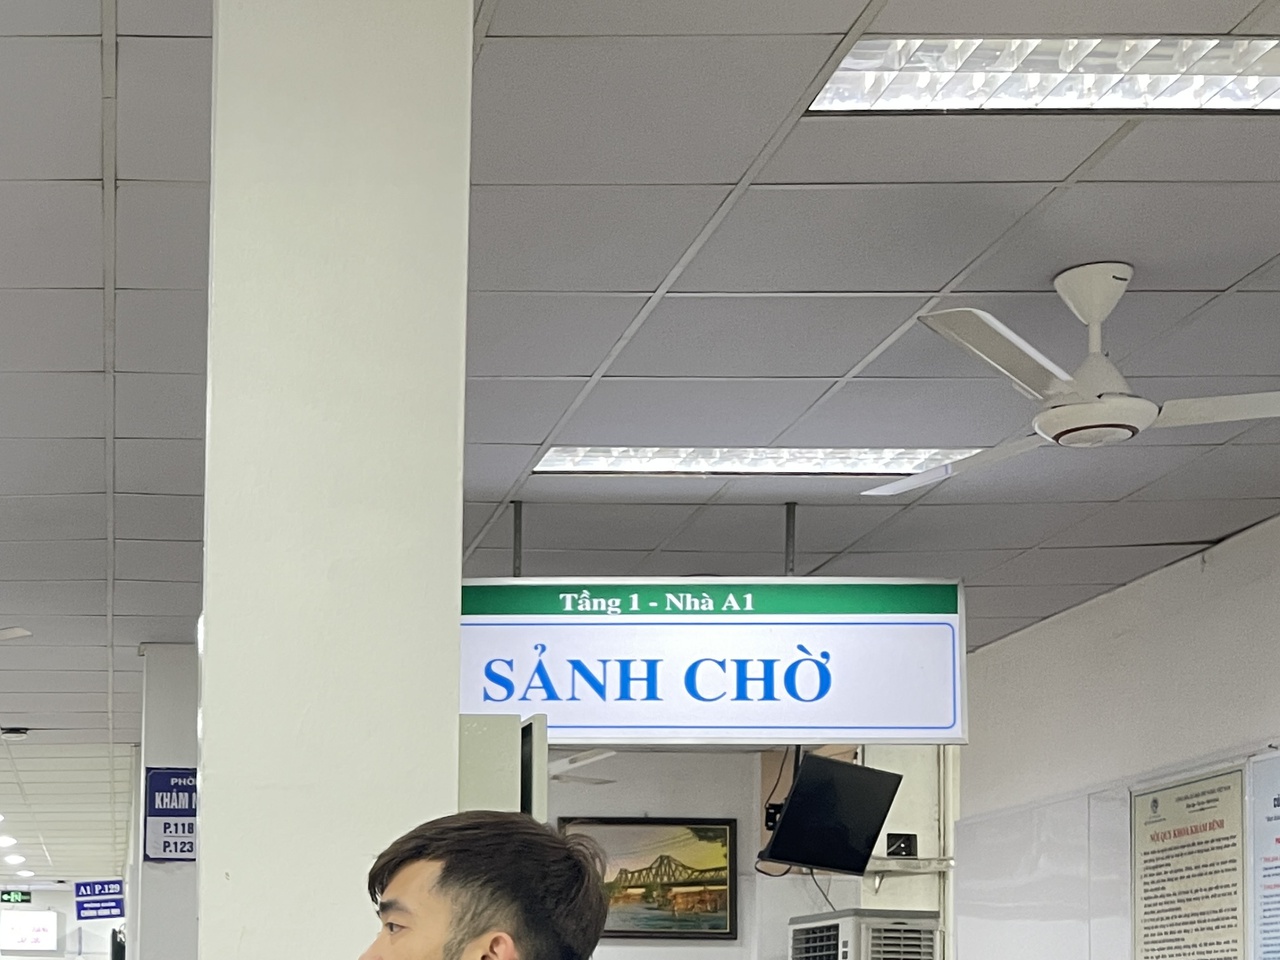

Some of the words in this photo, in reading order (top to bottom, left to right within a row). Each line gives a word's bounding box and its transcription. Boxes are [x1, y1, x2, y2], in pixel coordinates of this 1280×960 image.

[559, 589, 622, 615] Tầng
[629, 594, 641, 611] 1
[665, 592, 715, 612] Nhà
[721, 594, 755, 611] A1
[482, 643, 664, 703] SẢNH
[684, 643, 832, 703] CHỜ
[170, 776, 197, 786] PHÒ
[163, 822, 194, 834] P.118
[163, 841, 194, 853] P.123
[79, 885, 91, 895] A1
